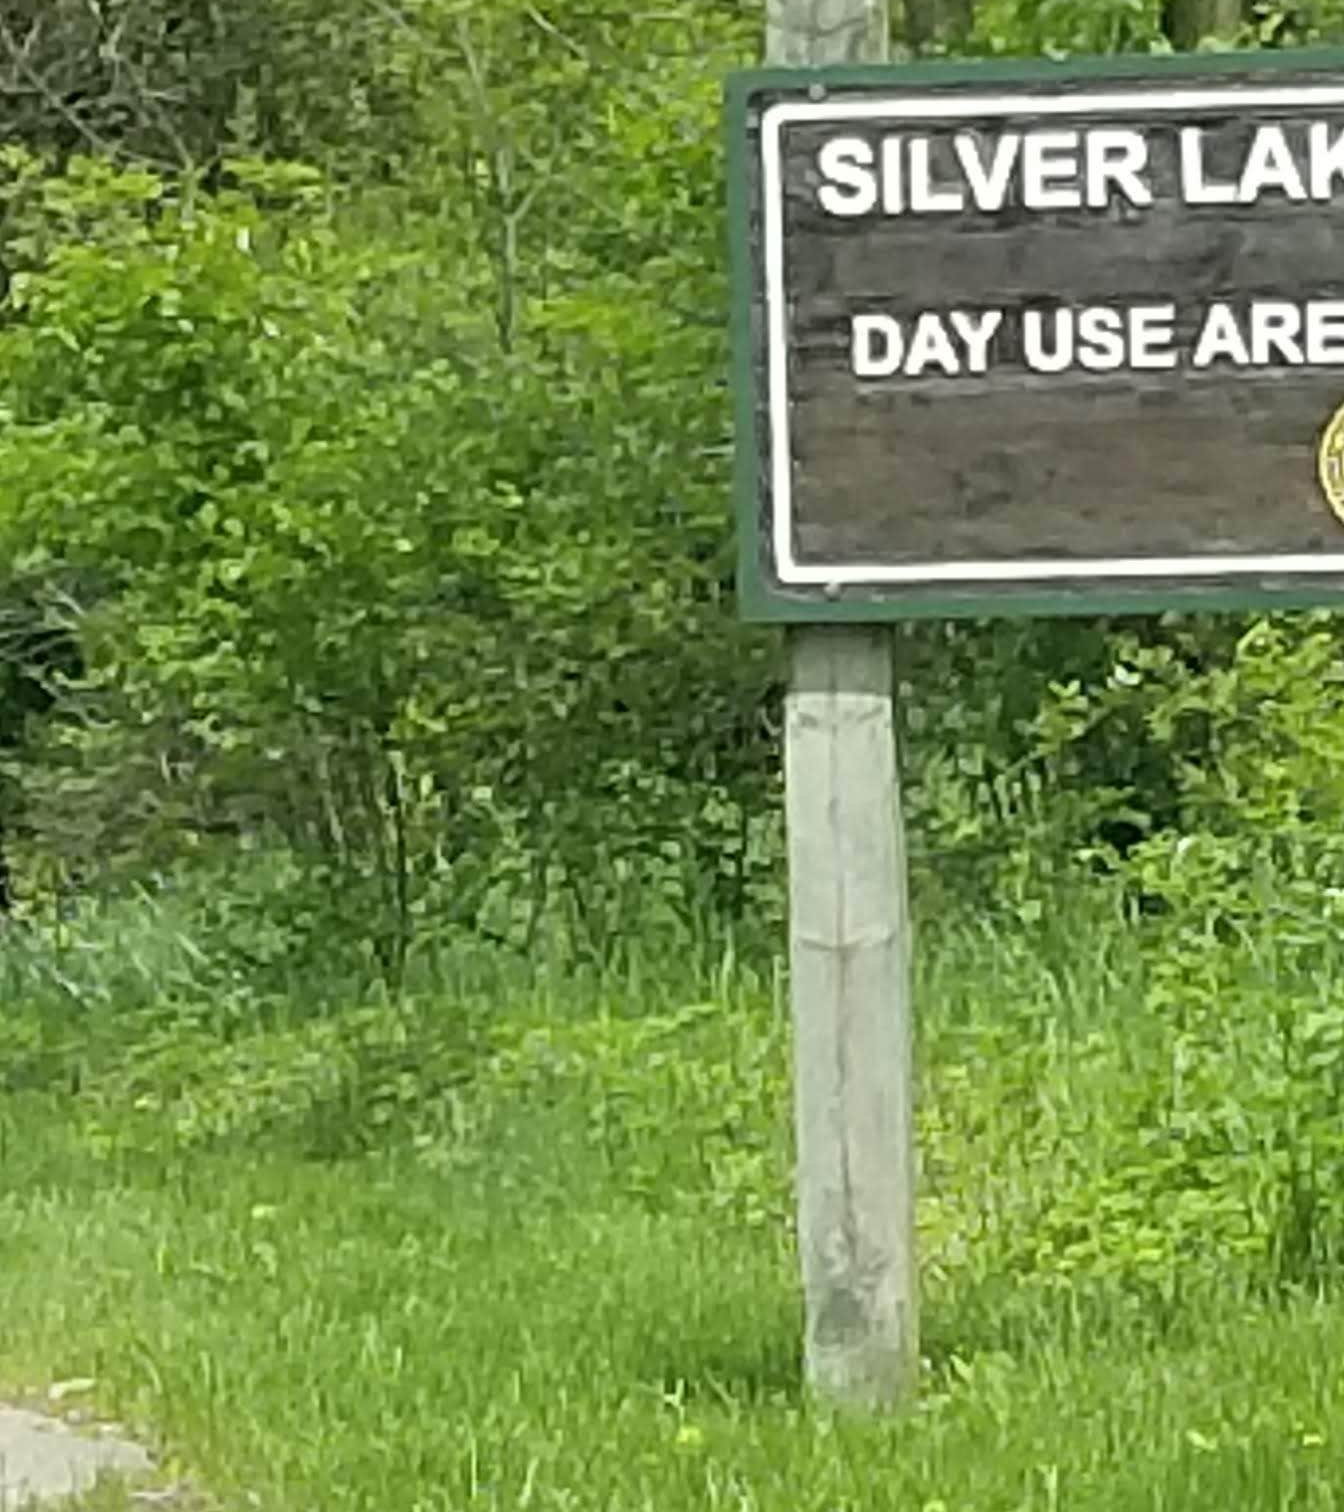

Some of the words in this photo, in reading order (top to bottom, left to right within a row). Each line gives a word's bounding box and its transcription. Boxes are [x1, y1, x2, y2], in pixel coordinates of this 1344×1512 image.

[816, 128, 1155, 216] SILVER
[851, 310, 1003, 377] DAY
[1022, 303, 1178, 373] USE
